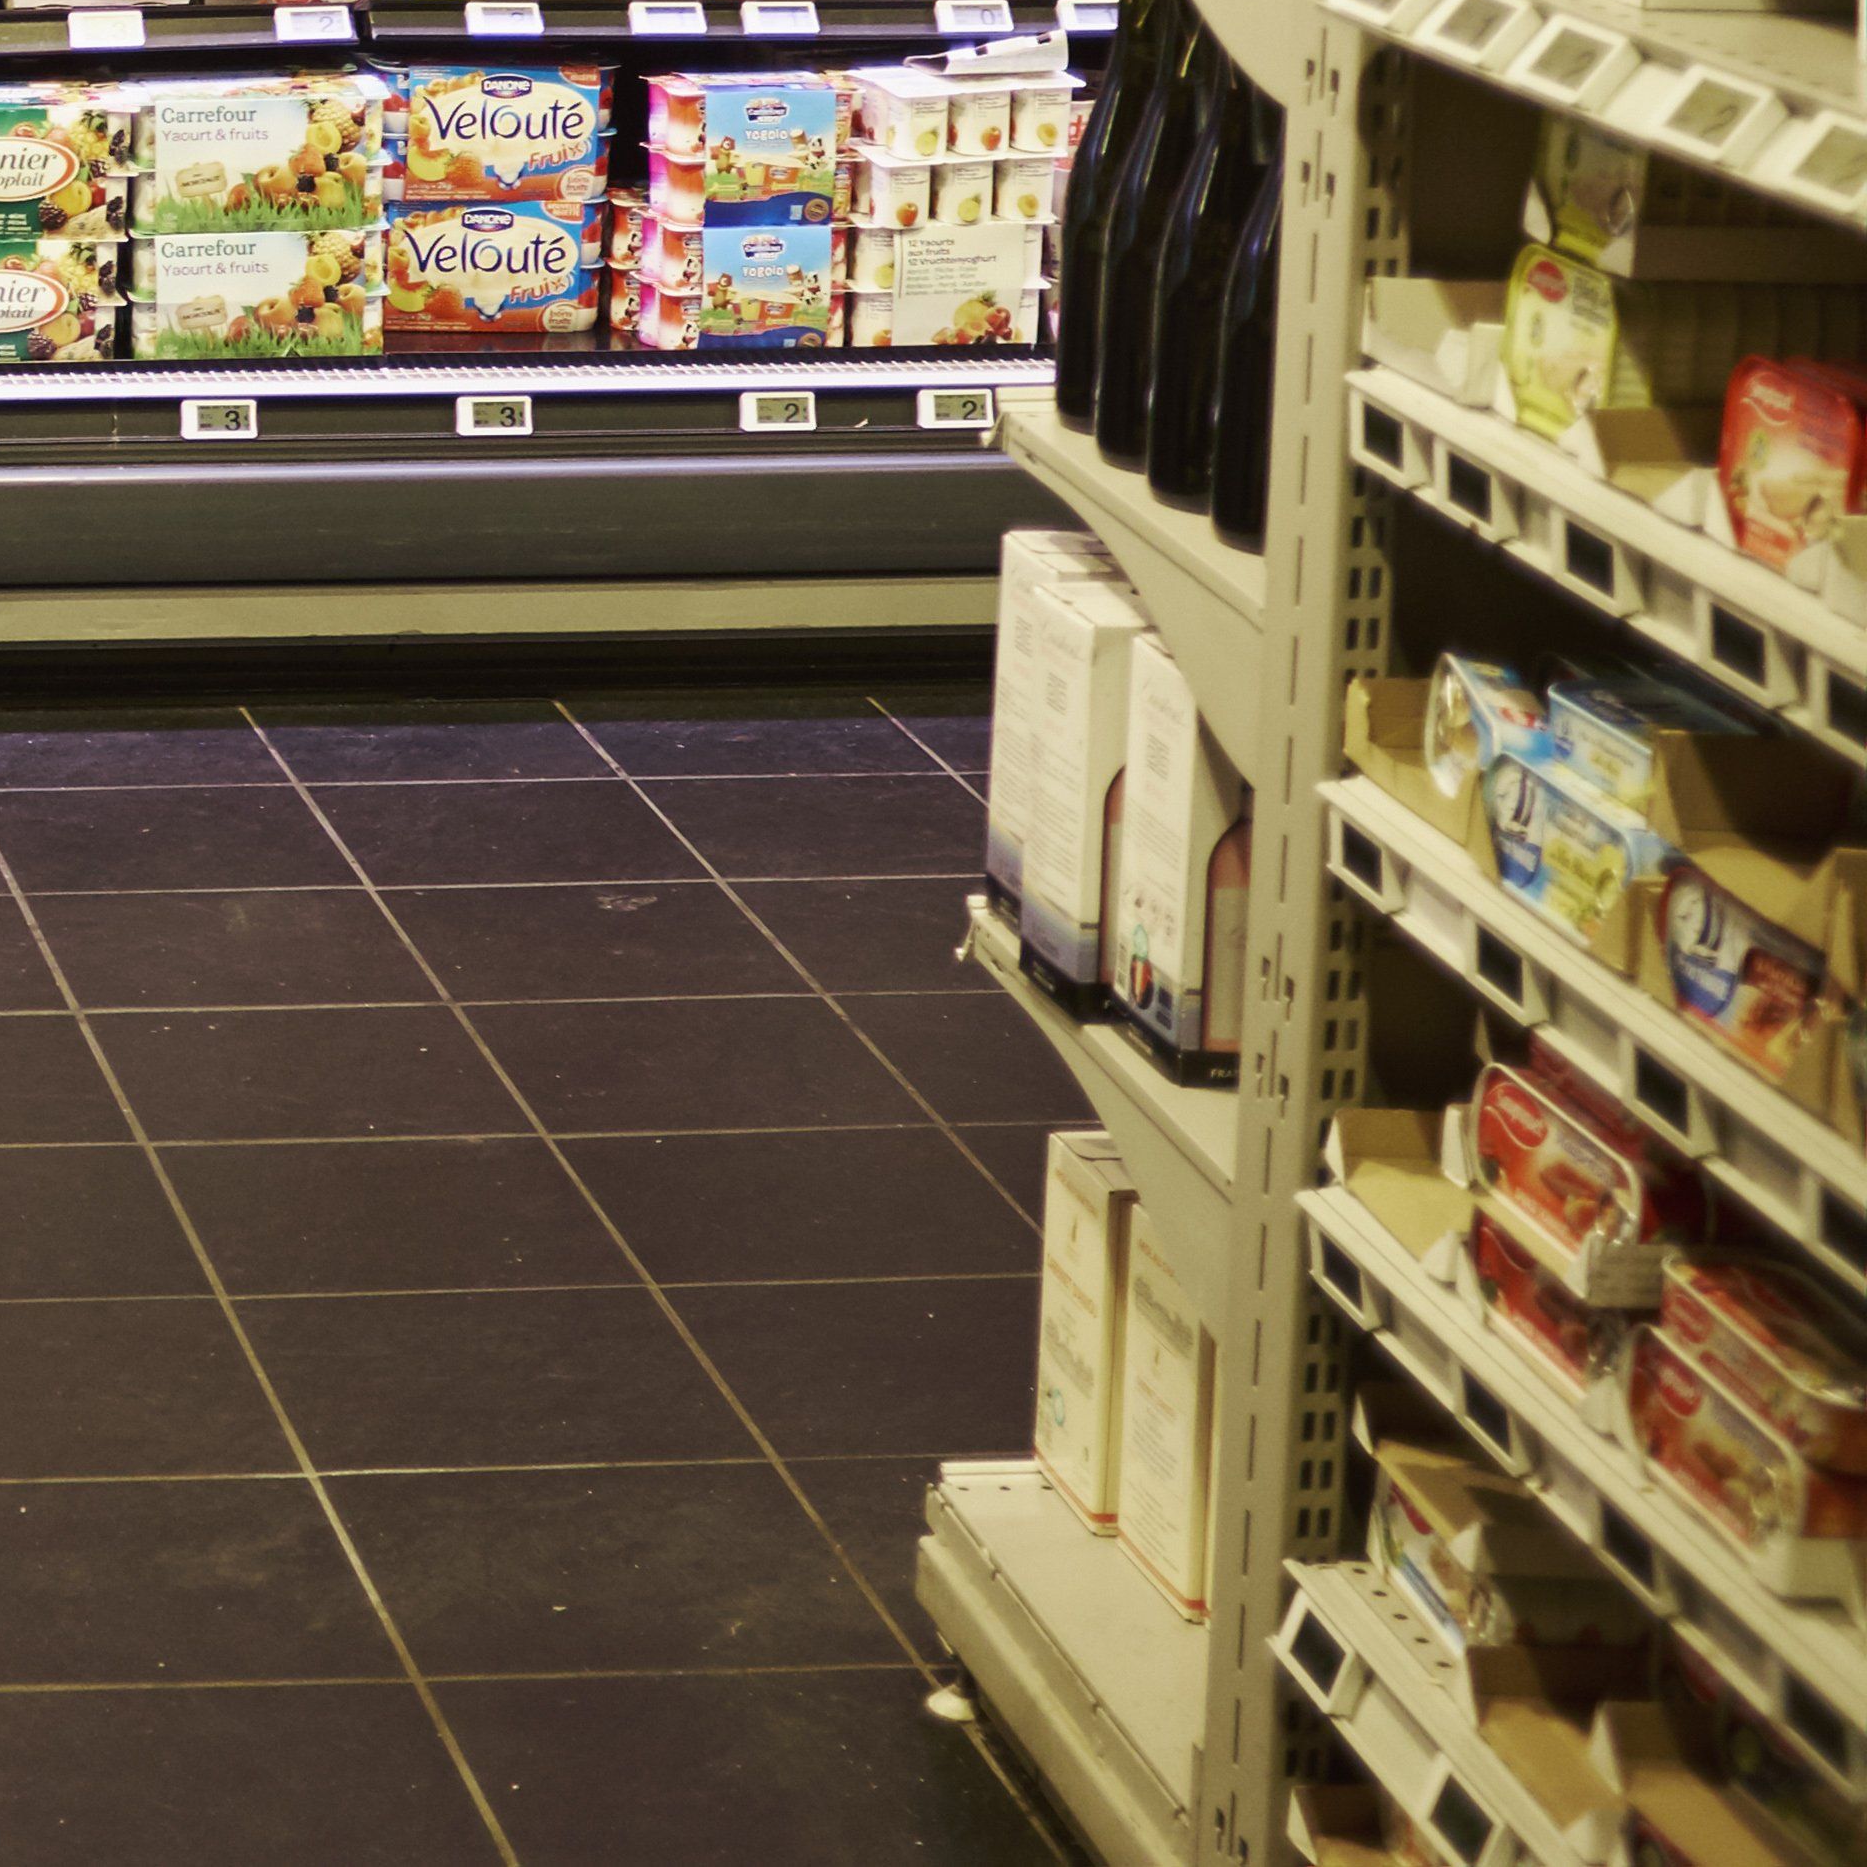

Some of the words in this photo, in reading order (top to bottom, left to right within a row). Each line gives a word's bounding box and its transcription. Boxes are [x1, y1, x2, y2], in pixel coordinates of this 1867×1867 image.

[483, 80, 531, 91] DANONE
[161, 105, 257, 125] Carrefour
[422, 94, 585, 141] Velouté
[162, 129, 213, 142] Yaourt
[216, 129, 227, 141] &
[229, 128, 269, 141] fruits
[464, 214, 512, 226] DANONE
[161, 241, 257, 259] Carrefour
[403, 229, 567, 275] Velouté
[162, 263, 213, 276] Yaourt
[216, 263, 227, 275] &
[229, 261, 269, 274] fruits
